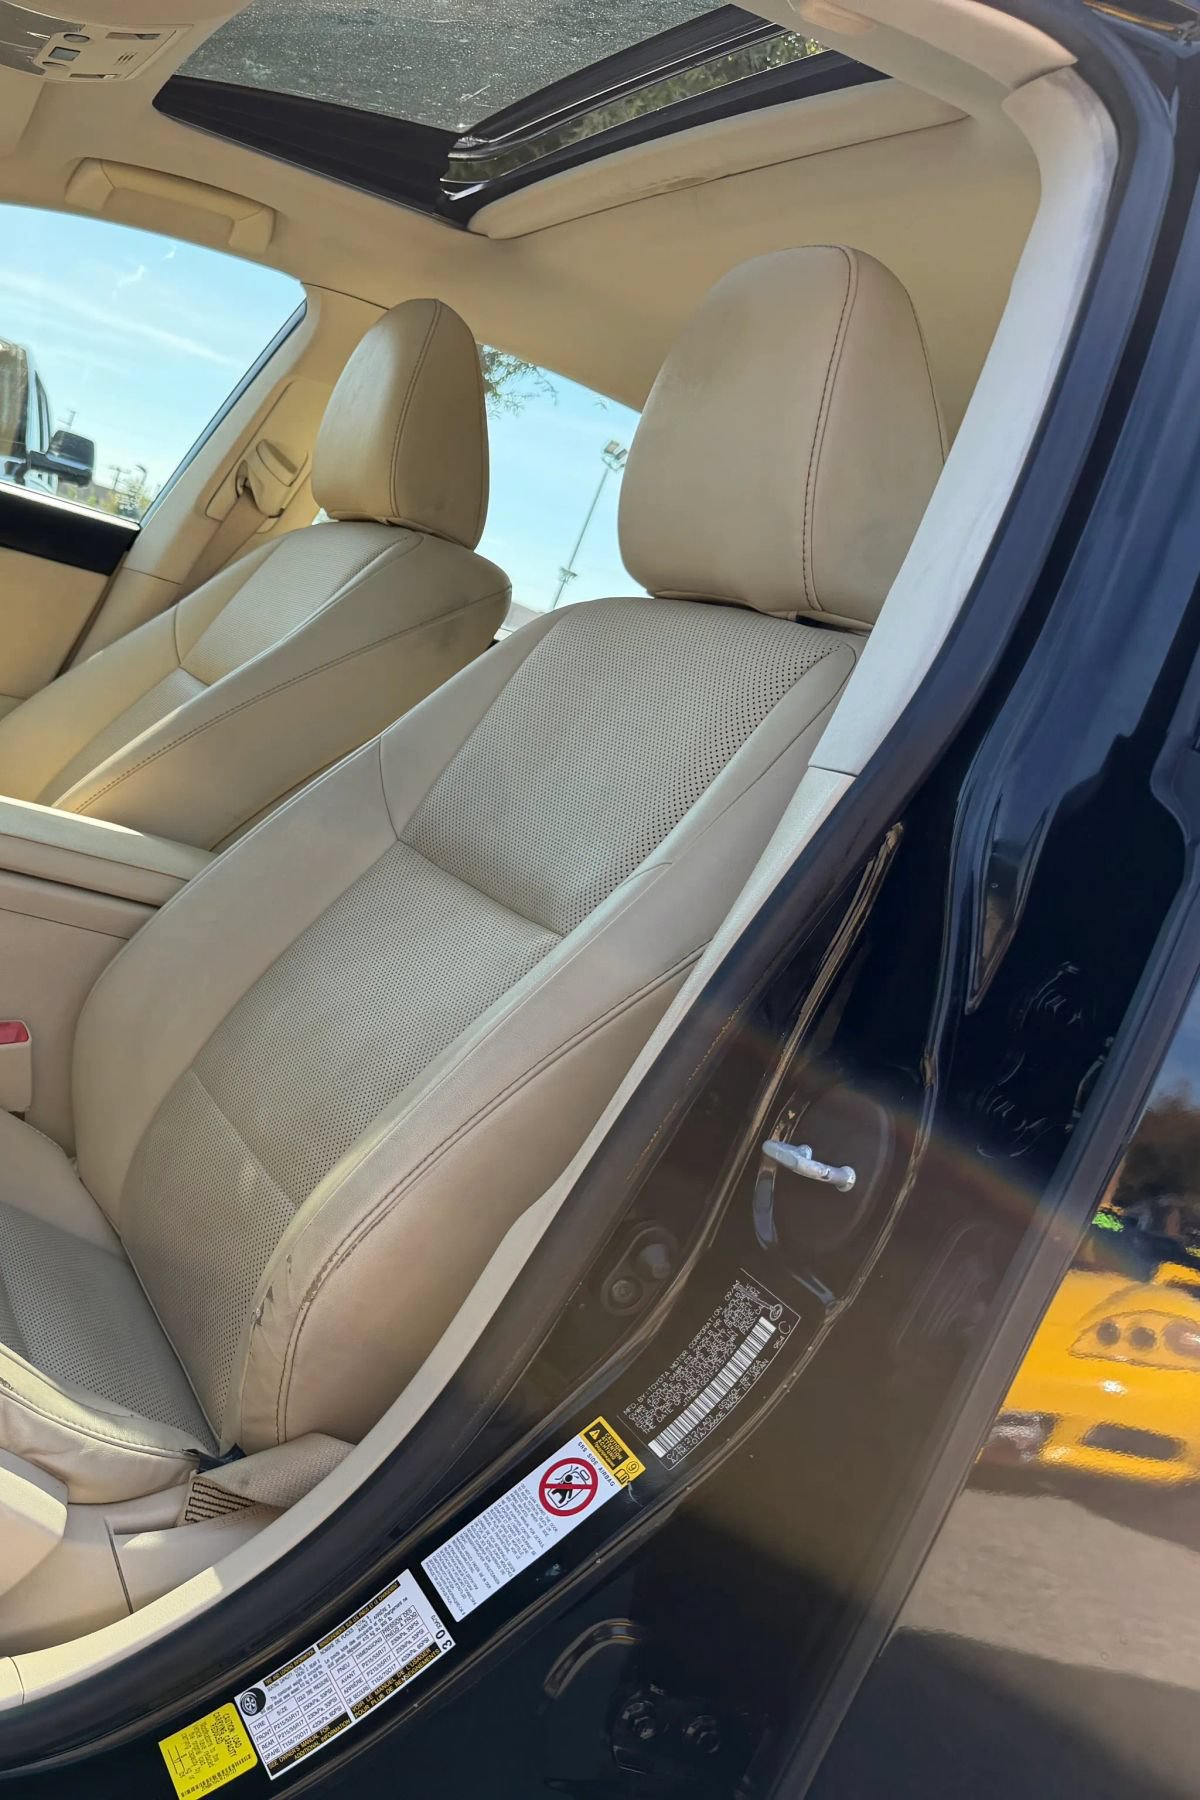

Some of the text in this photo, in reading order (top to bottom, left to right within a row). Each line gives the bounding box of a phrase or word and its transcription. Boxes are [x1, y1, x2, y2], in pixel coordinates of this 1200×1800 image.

[669, 1349, 688, 1370] MOTOR
[687, 1305, 723, 1350] CORPORATION
[749, 1357, 769, 1380] JAPAN
[597, 1438, 616, 1460] ACHTUNG
[600, 1435, 623, 1460] ATTENTION
[604, 1432, 622, 1452] CAUTION
[576, 1441, 587, 1452] SRS
[586, 1452, 598, 1465] SIDE
[597, 1466, 615, 1487] AIRBAG
[350, 1699, 365, 1712] VOIR
[365, 1692, 374, 1701] LE
[395, 1668, 405, 1678] DE
[353, 1703, 370, 1717] POUR
[369, 1692, 385, 1705] PLUS
[385, 1684, 395, 1694] DE
